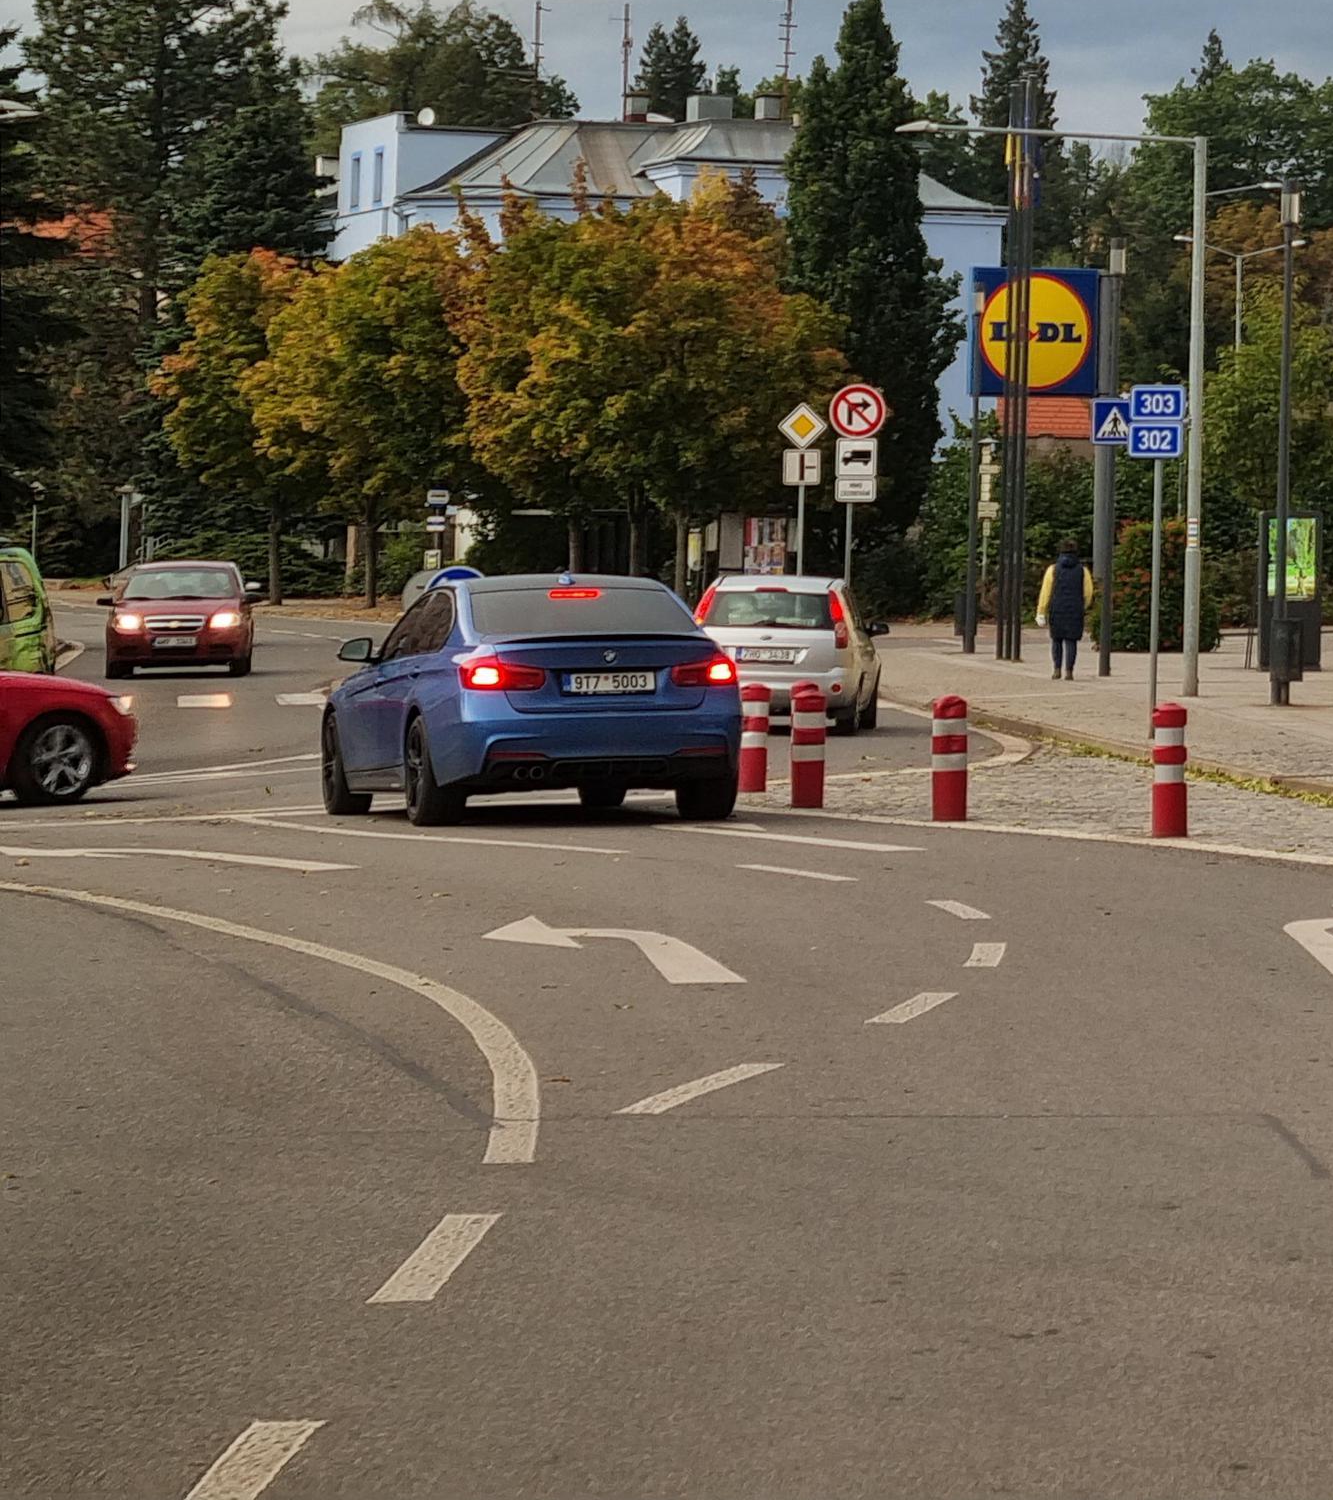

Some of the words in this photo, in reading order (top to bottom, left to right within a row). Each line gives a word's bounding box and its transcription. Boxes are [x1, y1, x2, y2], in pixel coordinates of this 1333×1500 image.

[1140, 393, 1175, 414] 303
[1137, 430, 1172, 450] 302
[574, 676, 601, 690] 9T7
[611, 674, 648, 689] 5003
